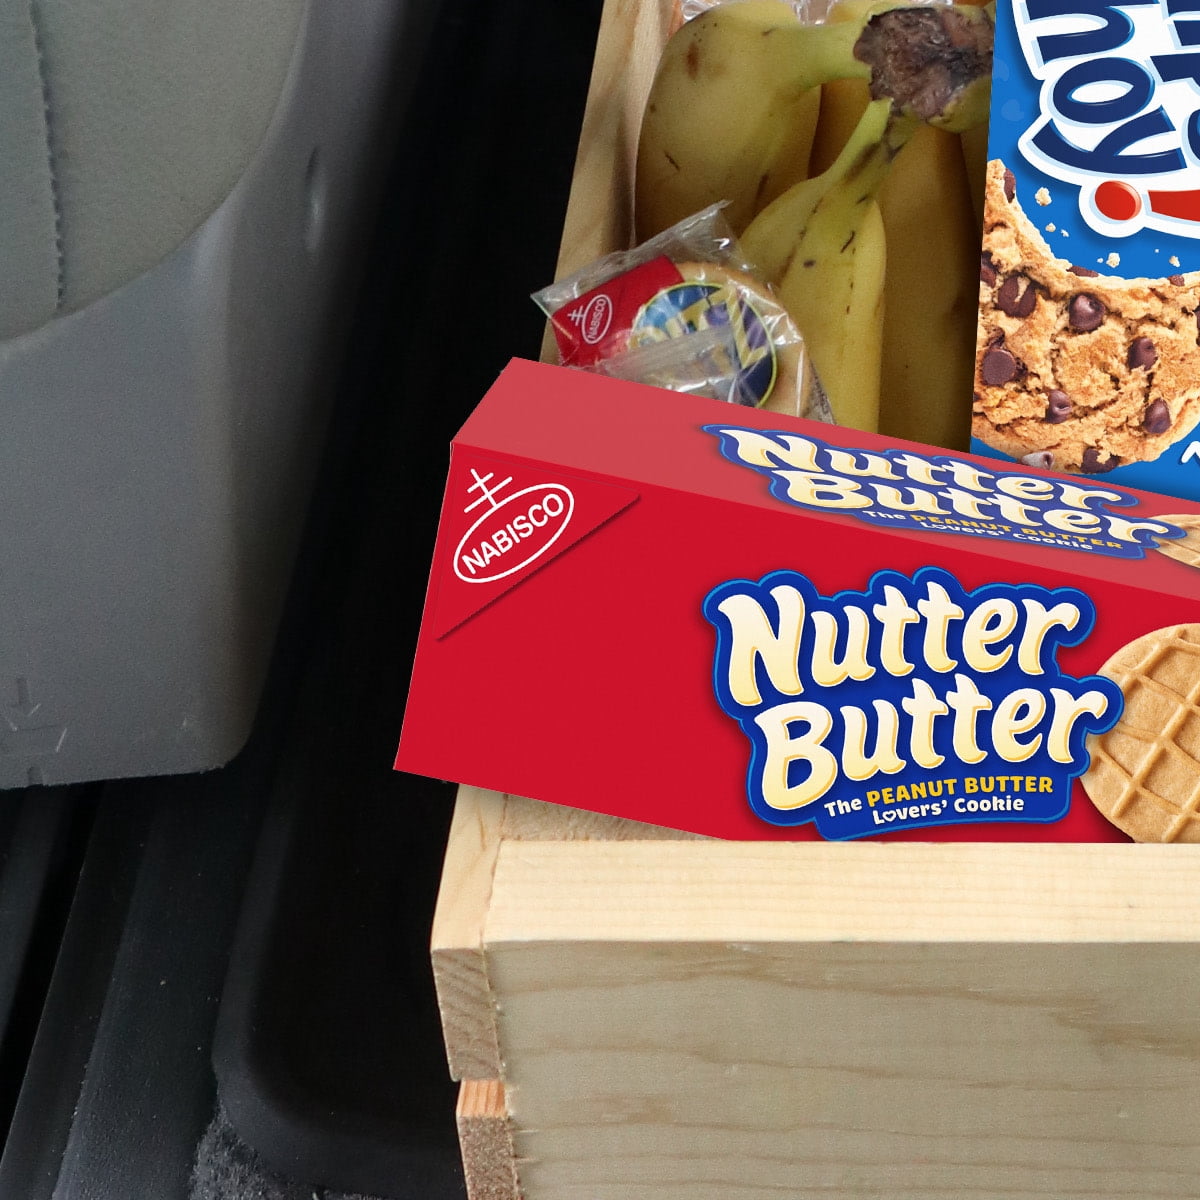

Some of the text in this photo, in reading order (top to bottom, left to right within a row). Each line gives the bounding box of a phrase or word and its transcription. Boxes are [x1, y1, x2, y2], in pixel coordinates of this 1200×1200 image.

[586, 297, 607, 341] NABISCO
[718, 428, 1122, 507] Nutter
[461, 493, 564, 575] NABISCO
[772, 469, 1170, 545] Butter
[862, 510, 1124, 549] The PEANUT BUTTER
[919, 520, 1093, 550] Lovers' Cookie
[717, 581, 1081, 707] Nutter
[754, 673, 1109, 811] Butter
[824, 775, 1054, 818] The PEANUT BUTTER
[872, 794, 1025, 826] Lovers' Cookie
